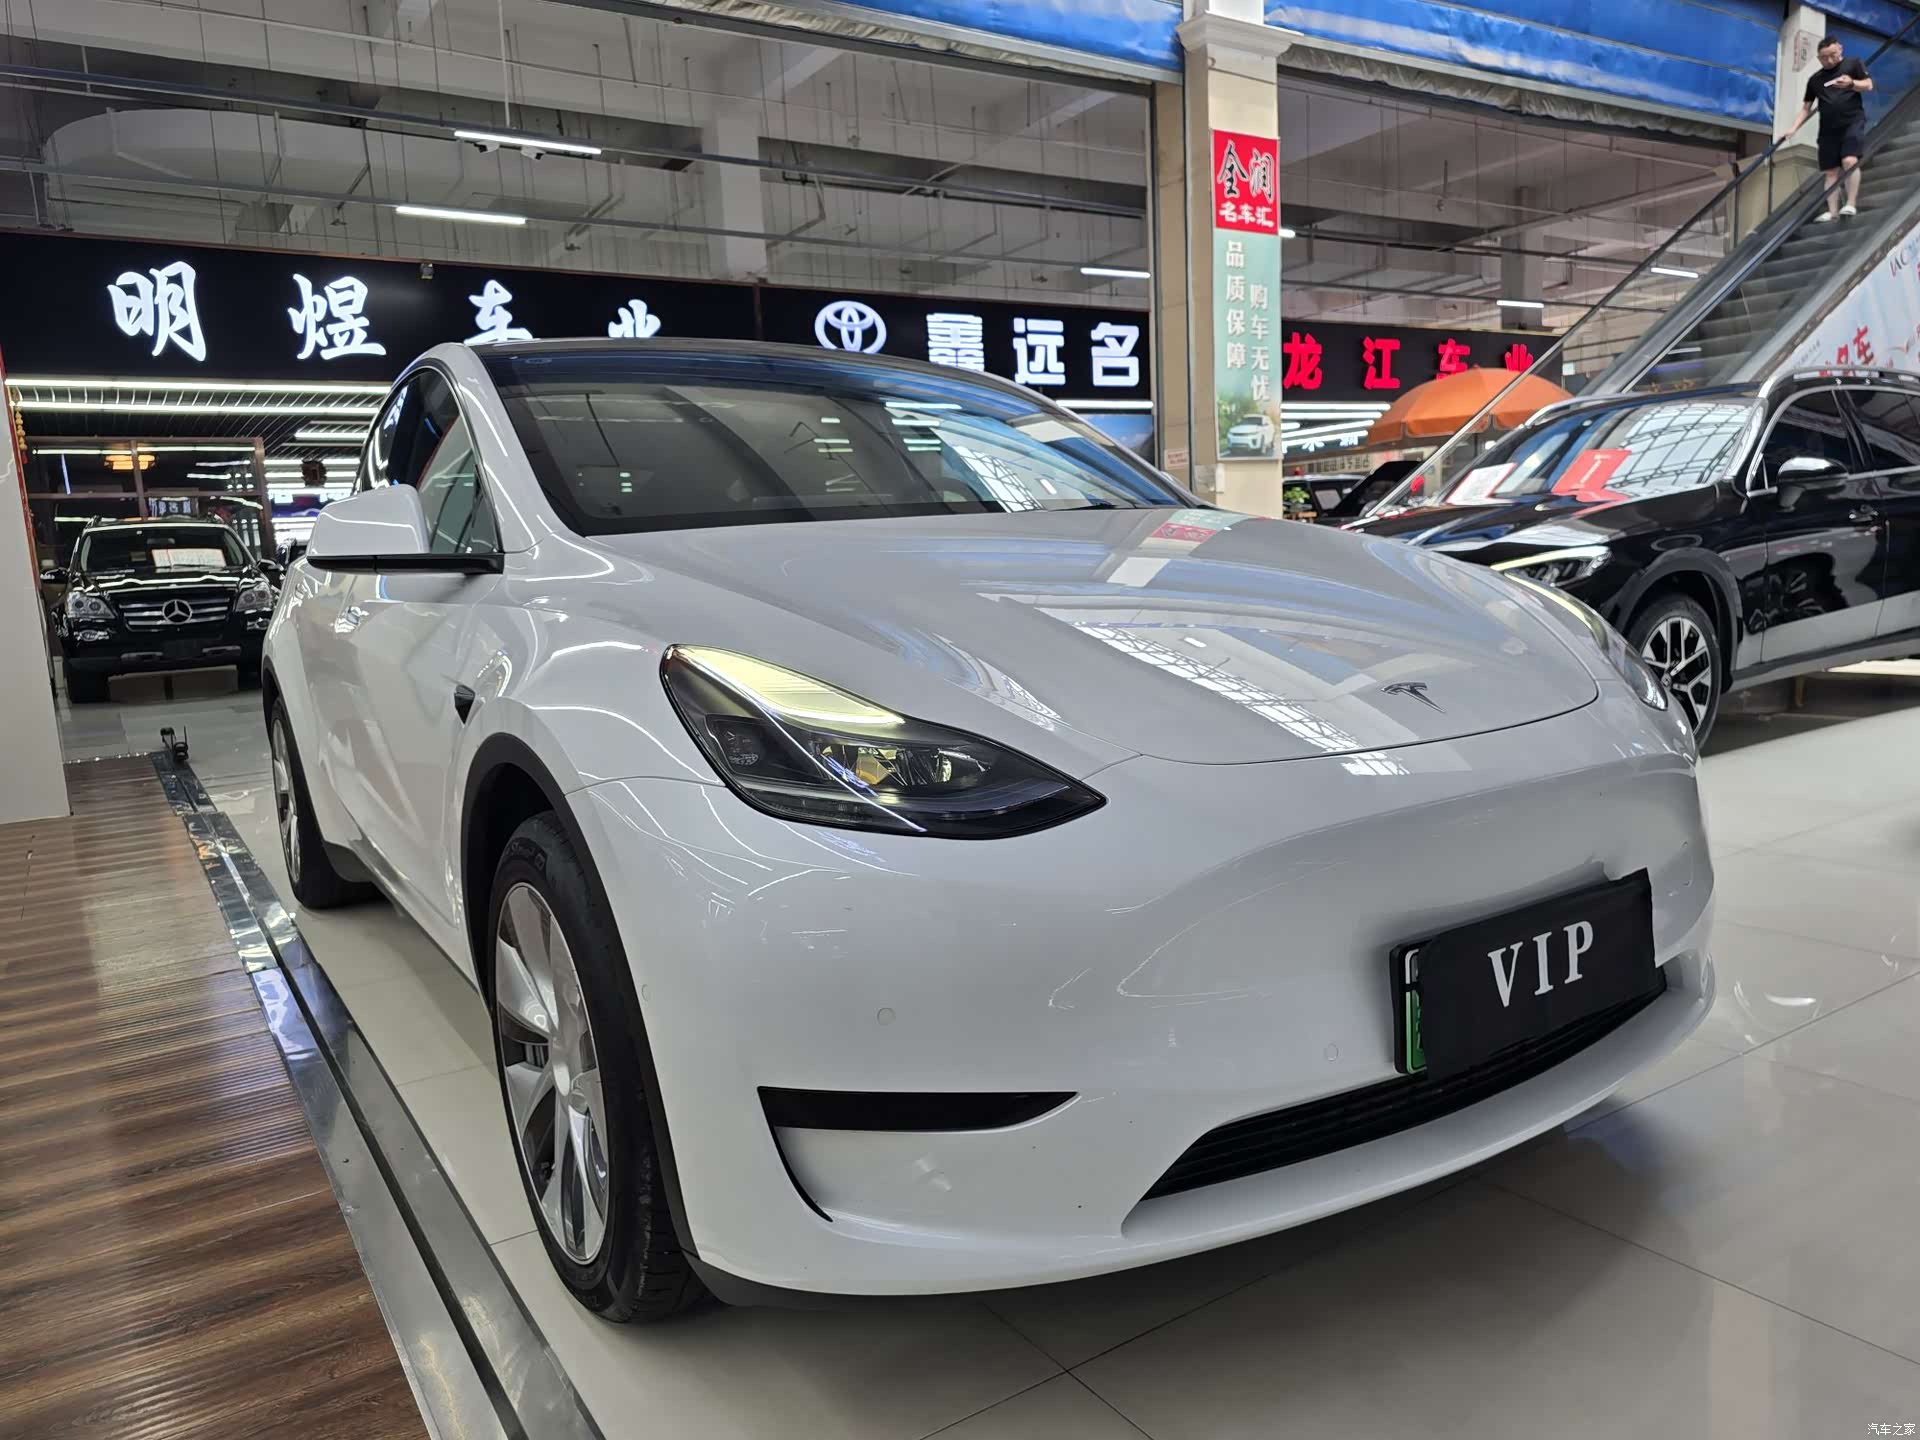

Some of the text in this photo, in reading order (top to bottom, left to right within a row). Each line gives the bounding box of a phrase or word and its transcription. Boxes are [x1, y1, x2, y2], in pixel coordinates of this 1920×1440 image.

[1218, 201, 1275, 228] 名车汇
[1225, 239, 1247, 370] 品质保障
[1249, 283, 1271, 402] 购车无忧
[926, 312, 1141, 387] 鑫远名
[1487, 920, 1594, 1008] VIP
